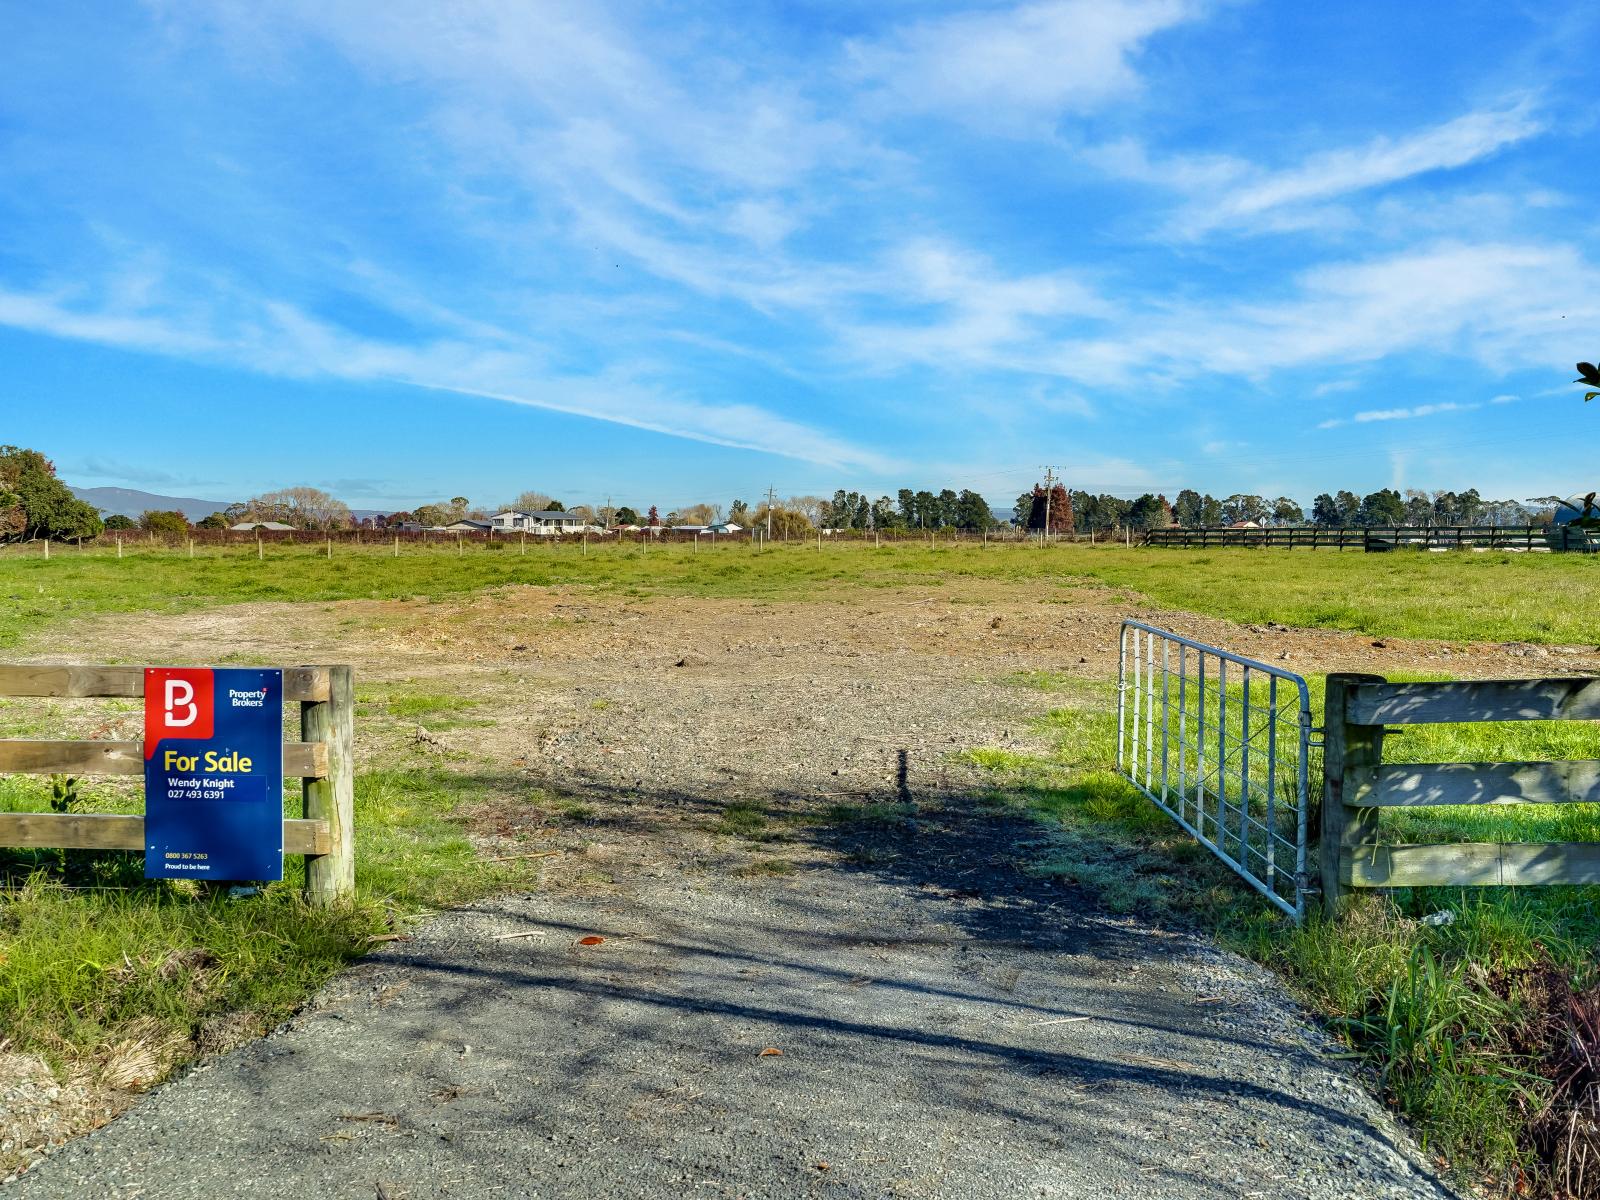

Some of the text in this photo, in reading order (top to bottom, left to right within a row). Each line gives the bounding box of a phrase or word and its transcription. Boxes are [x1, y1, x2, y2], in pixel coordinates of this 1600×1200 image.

[229, 689, 266, 700] Property
[232, 698, 263, 707] Brokers
[164, 750, 252, 773] For Sale
[168, 777, 235, 790] Wendy Knight
[168, 790, 225, 799] 027 493 6391
